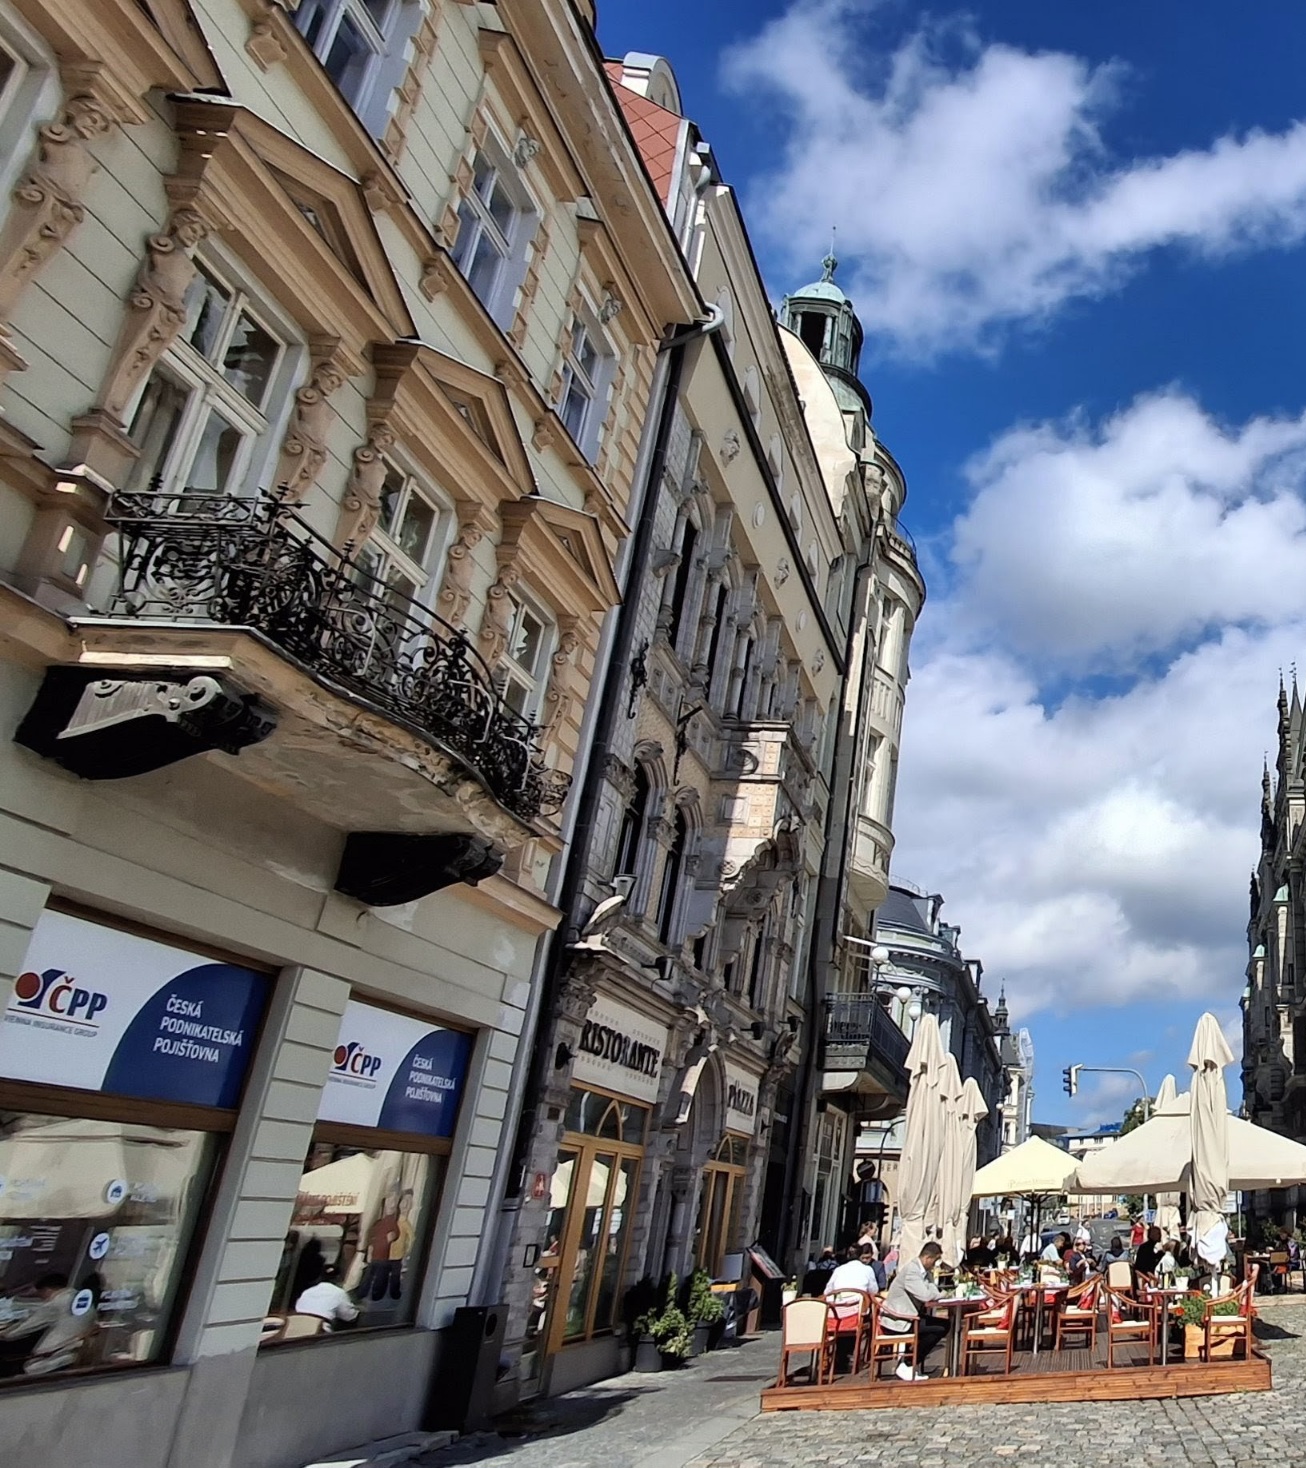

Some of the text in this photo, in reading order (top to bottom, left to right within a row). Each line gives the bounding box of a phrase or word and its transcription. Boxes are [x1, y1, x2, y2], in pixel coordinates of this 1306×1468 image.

[49, 975, 108, 1021] ČPP
[166, 993, 204, 1018] ČESKÁ
[159, 1016, 245, 1047] PODNIKATELSKÁ
[152, 1037, 220, 1063] POJIŠŤOVNA
[350, 1046, 382, 1077] ČPP
[578, 1018, 661, 1079] RISTORANTE
